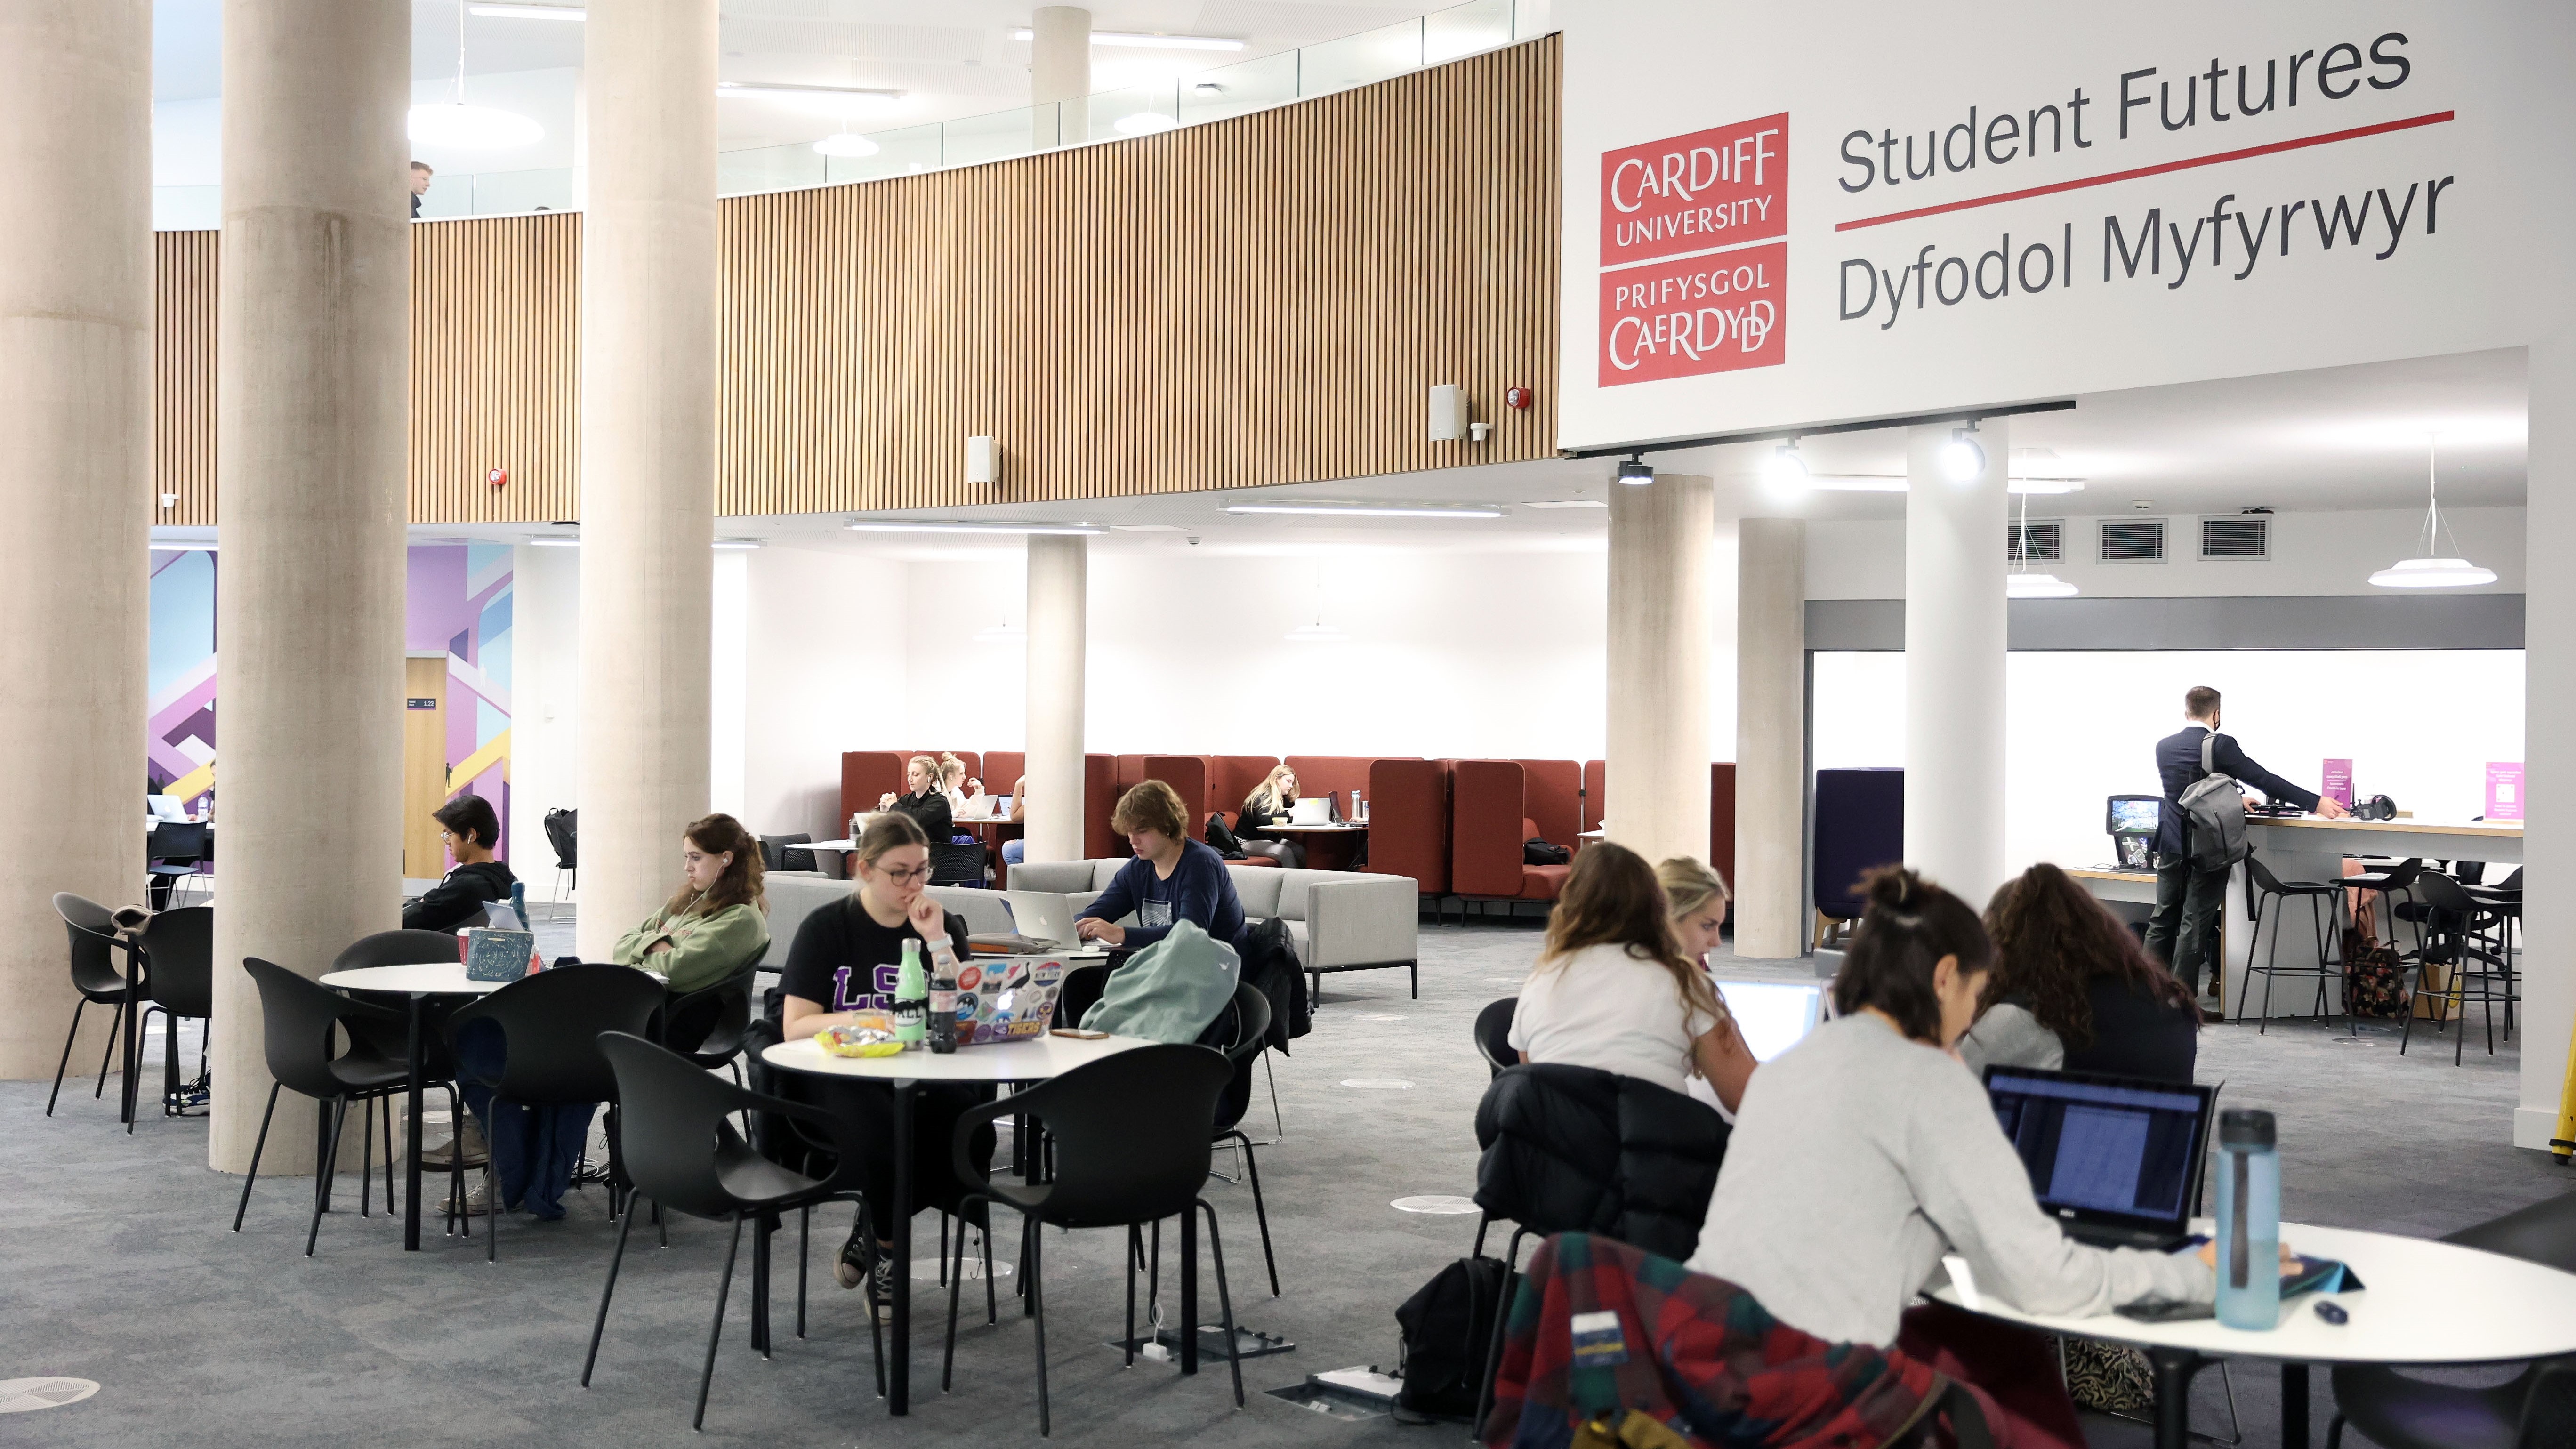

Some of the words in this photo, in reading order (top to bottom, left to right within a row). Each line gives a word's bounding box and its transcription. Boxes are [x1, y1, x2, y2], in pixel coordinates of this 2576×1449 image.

[1838, 87, 2092, 193] Student
[2119, 31, 2411, 141] Futures
[1611, 129, 1779, 213] CARDIFF
[1616, 194, 1772, 247] UNIVERSITY
[1839, 209, 2072, 330] Dyfodol
[2103, 175, 2455, 290] Myfyrwyr
[1615, 263, 1770, 311] PRIFYSGOL
[1609, 299, 1775, 370] CAERDYDD
[1007, 1021, 1042, 1036] TIGERS
